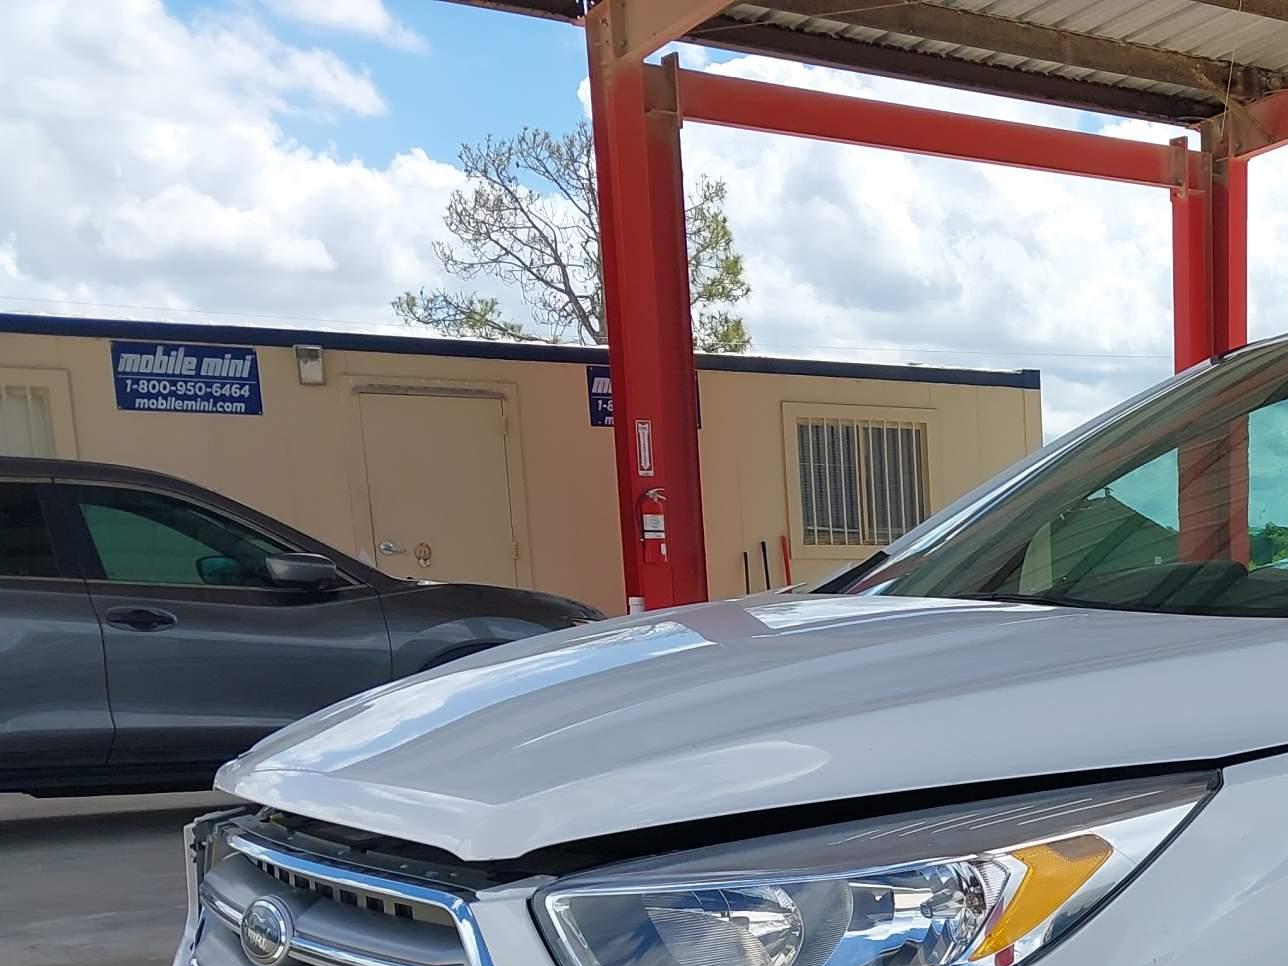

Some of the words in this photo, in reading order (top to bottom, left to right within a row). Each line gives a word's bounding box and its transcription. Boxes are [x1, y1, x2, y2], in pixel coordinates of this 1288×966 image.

[117, 346, 196, 375] mobile
[200, 353, 252, 378] mini
[126, 379, 250, 397] 1-800-950-6464
[135, 396, 246, 413] mobilemini.com
